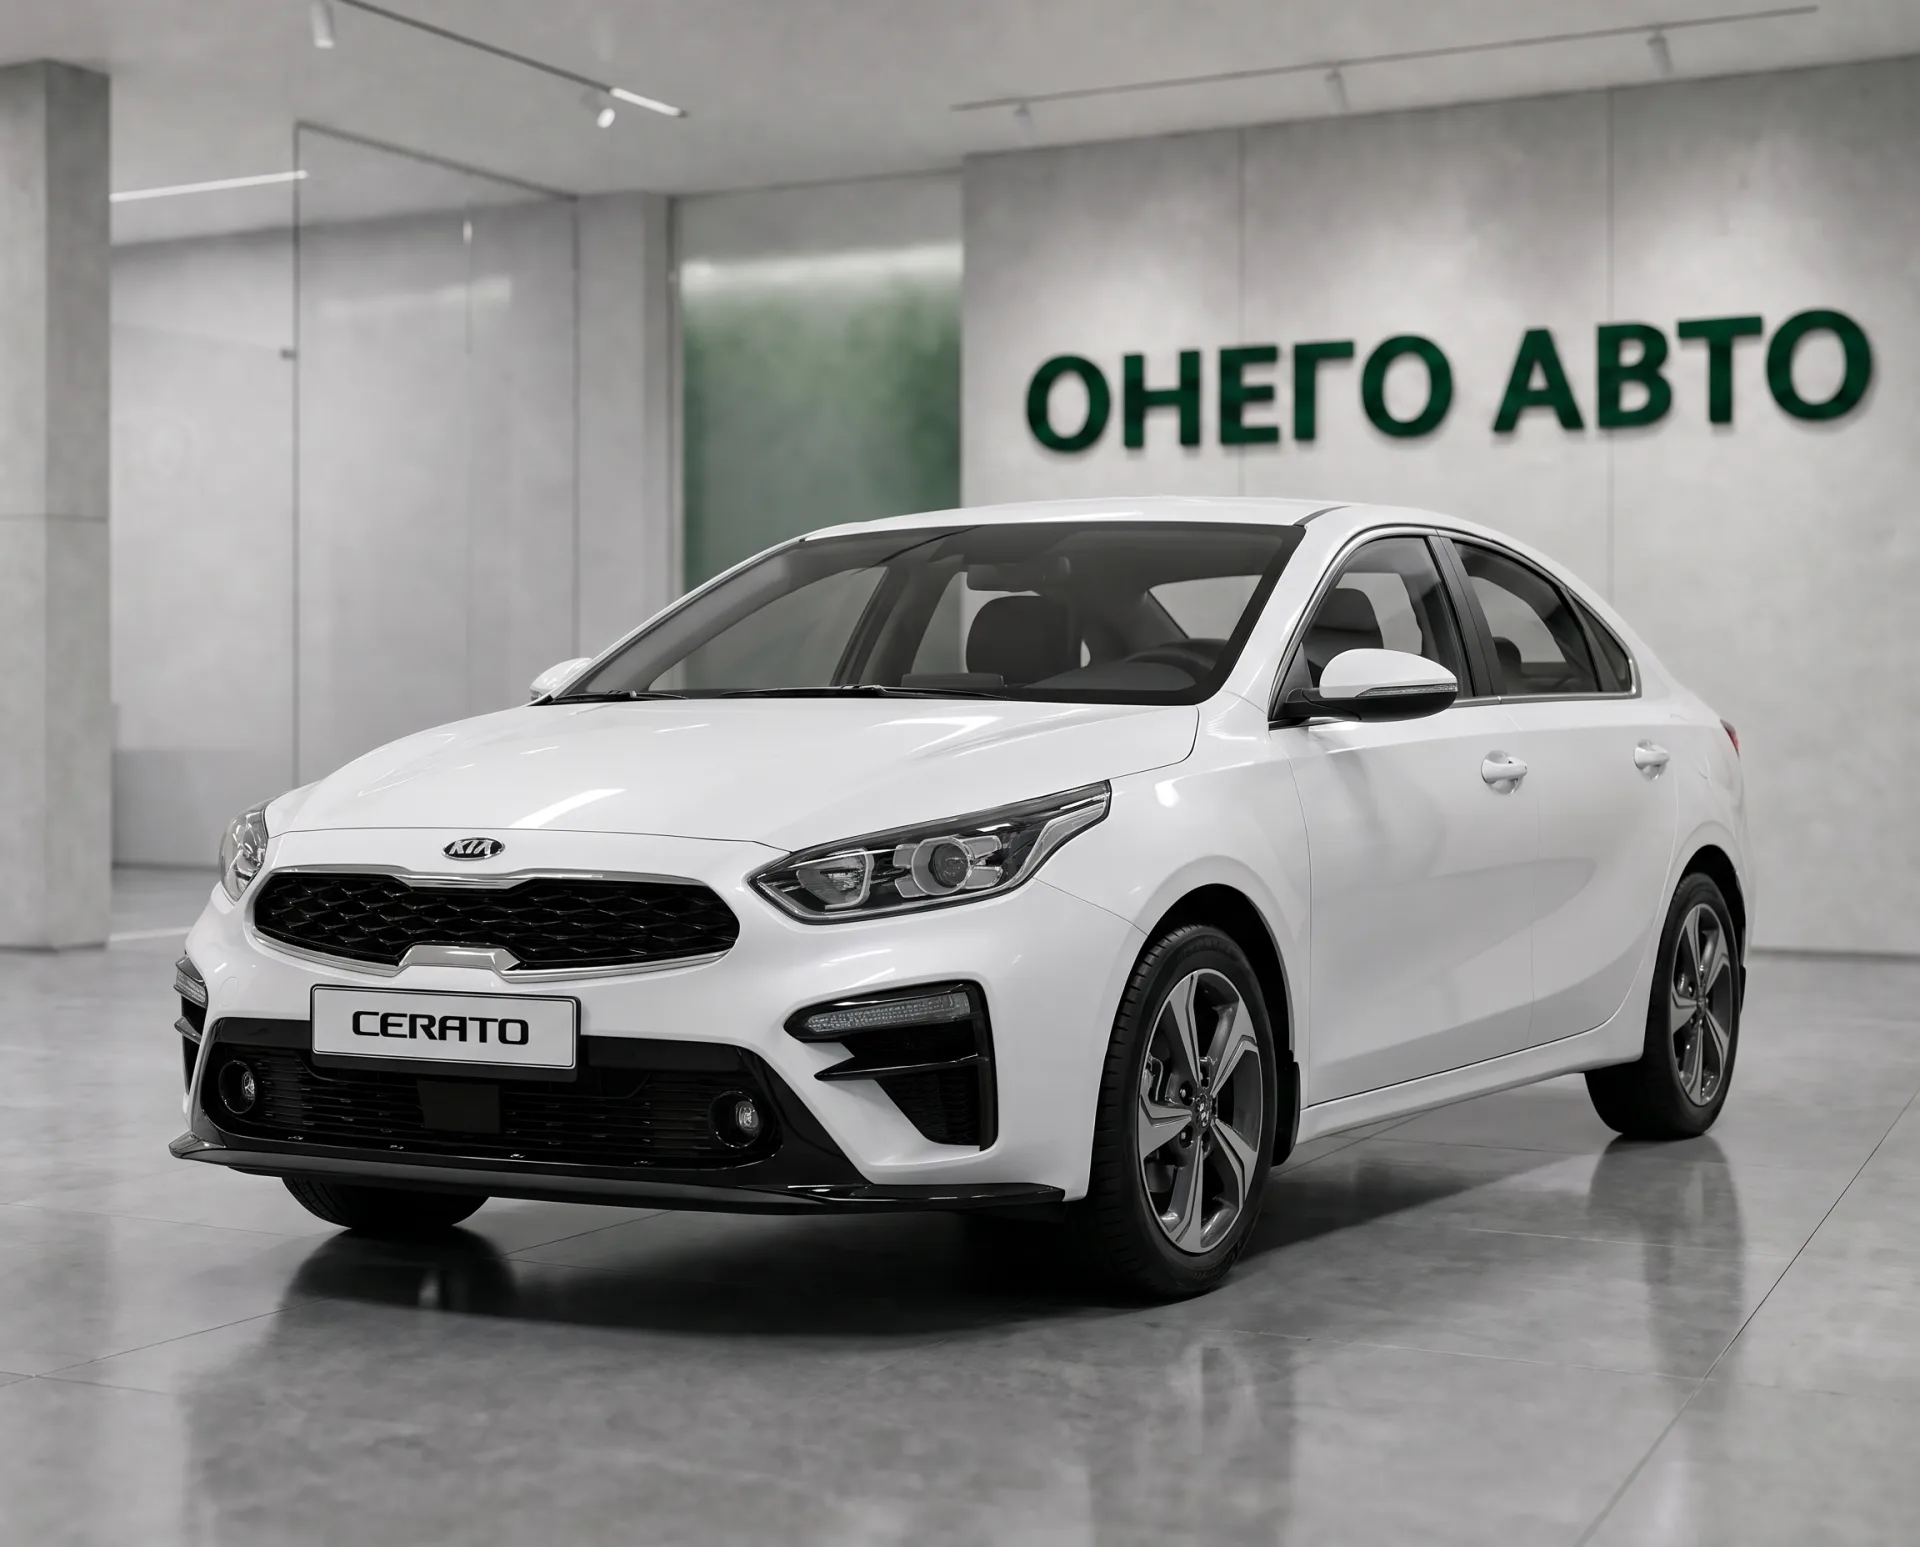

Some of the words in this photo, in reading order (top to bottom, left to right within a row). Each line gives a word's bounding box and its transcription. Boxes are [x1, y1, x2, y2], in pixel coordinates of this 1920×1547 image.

[1027, 336, 1453, 453] ОНЕГО
[1493, 309, 1872, 433] АВТО
[448, 839, 494, 855] KIA
[352, 1010, 529, 1046] CERATO
